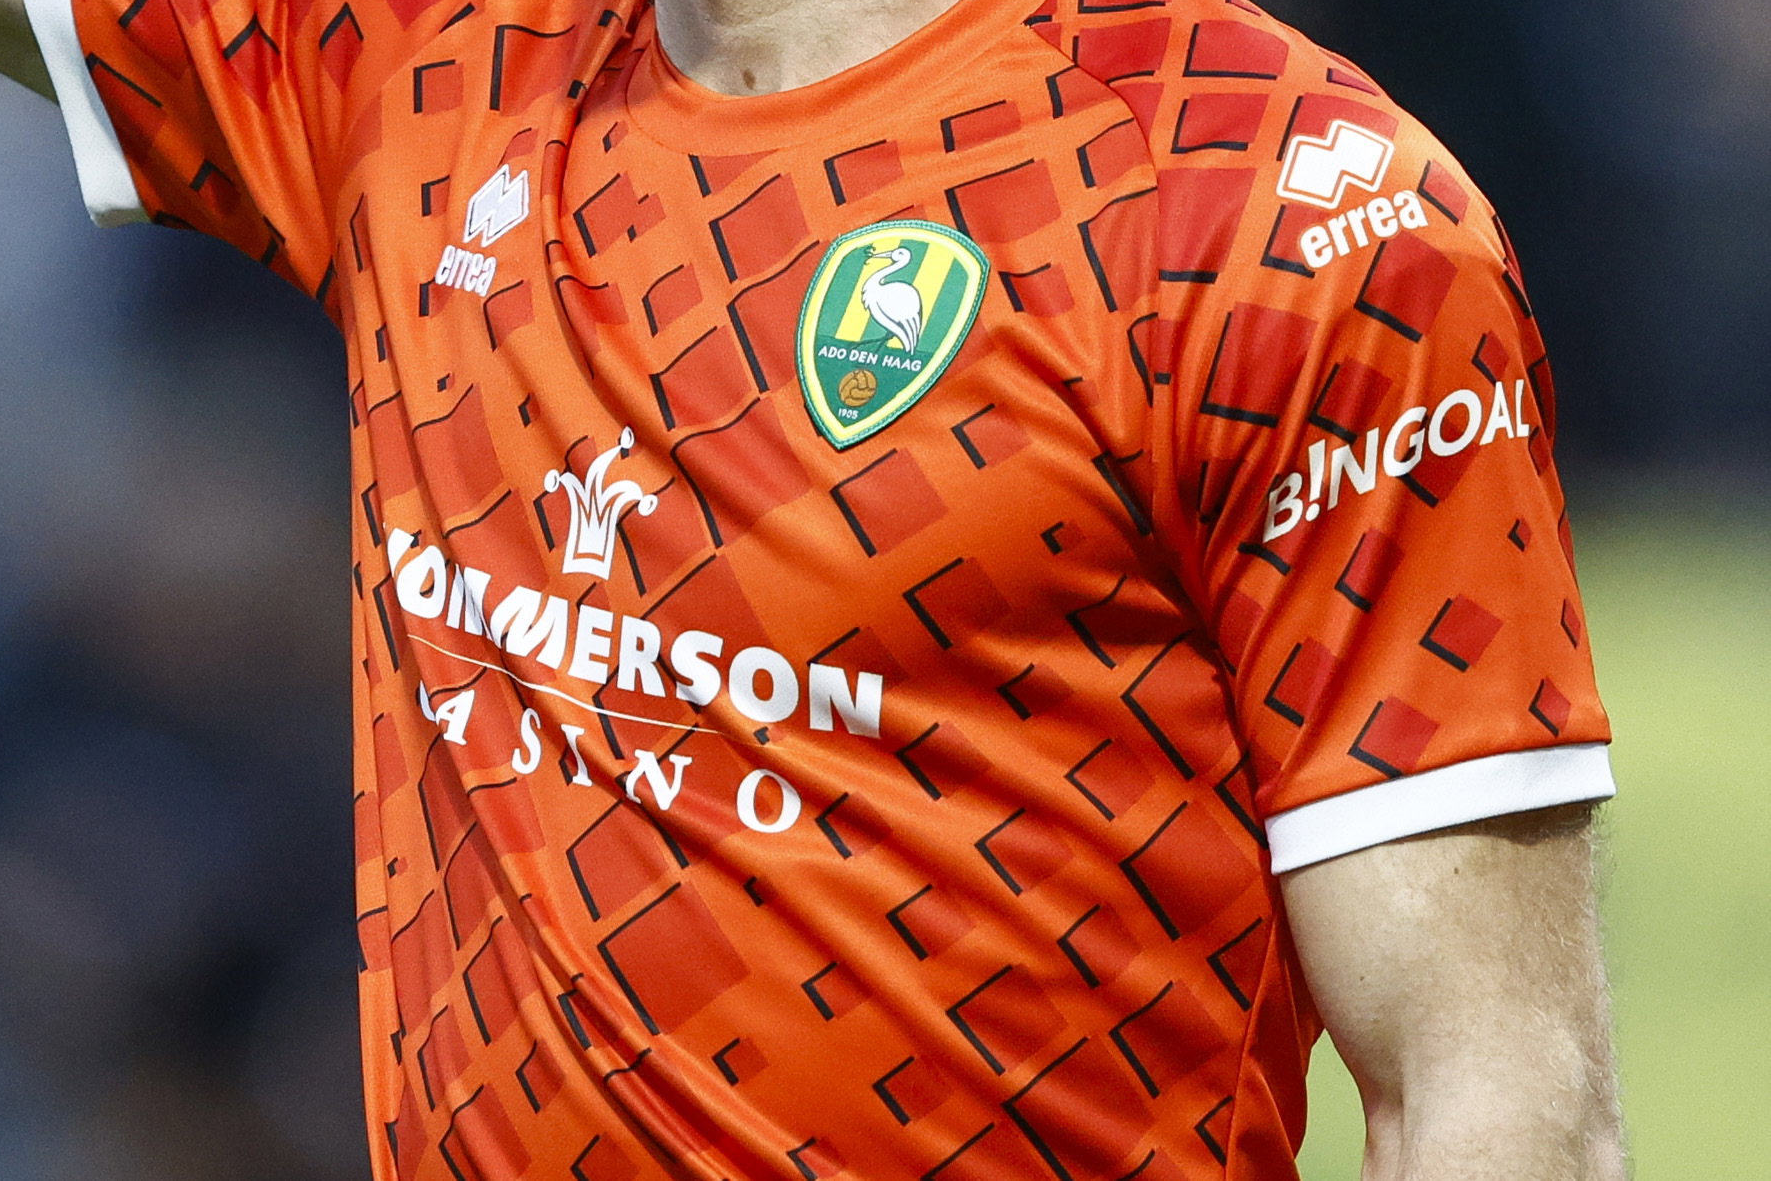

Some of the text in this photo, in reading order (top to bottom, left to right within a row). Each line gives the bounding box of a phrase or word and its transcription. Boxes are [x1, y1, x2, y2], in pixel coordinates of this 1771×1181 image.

[1299, 188, 1429, 269] errea
[434, 244, 498, 298] errea
[818, 345, 923, 372] ADO DEN HAAG
[837, 407, 860, 421] 1905
[1262, 378, 1530, 543] B!NGOAL
